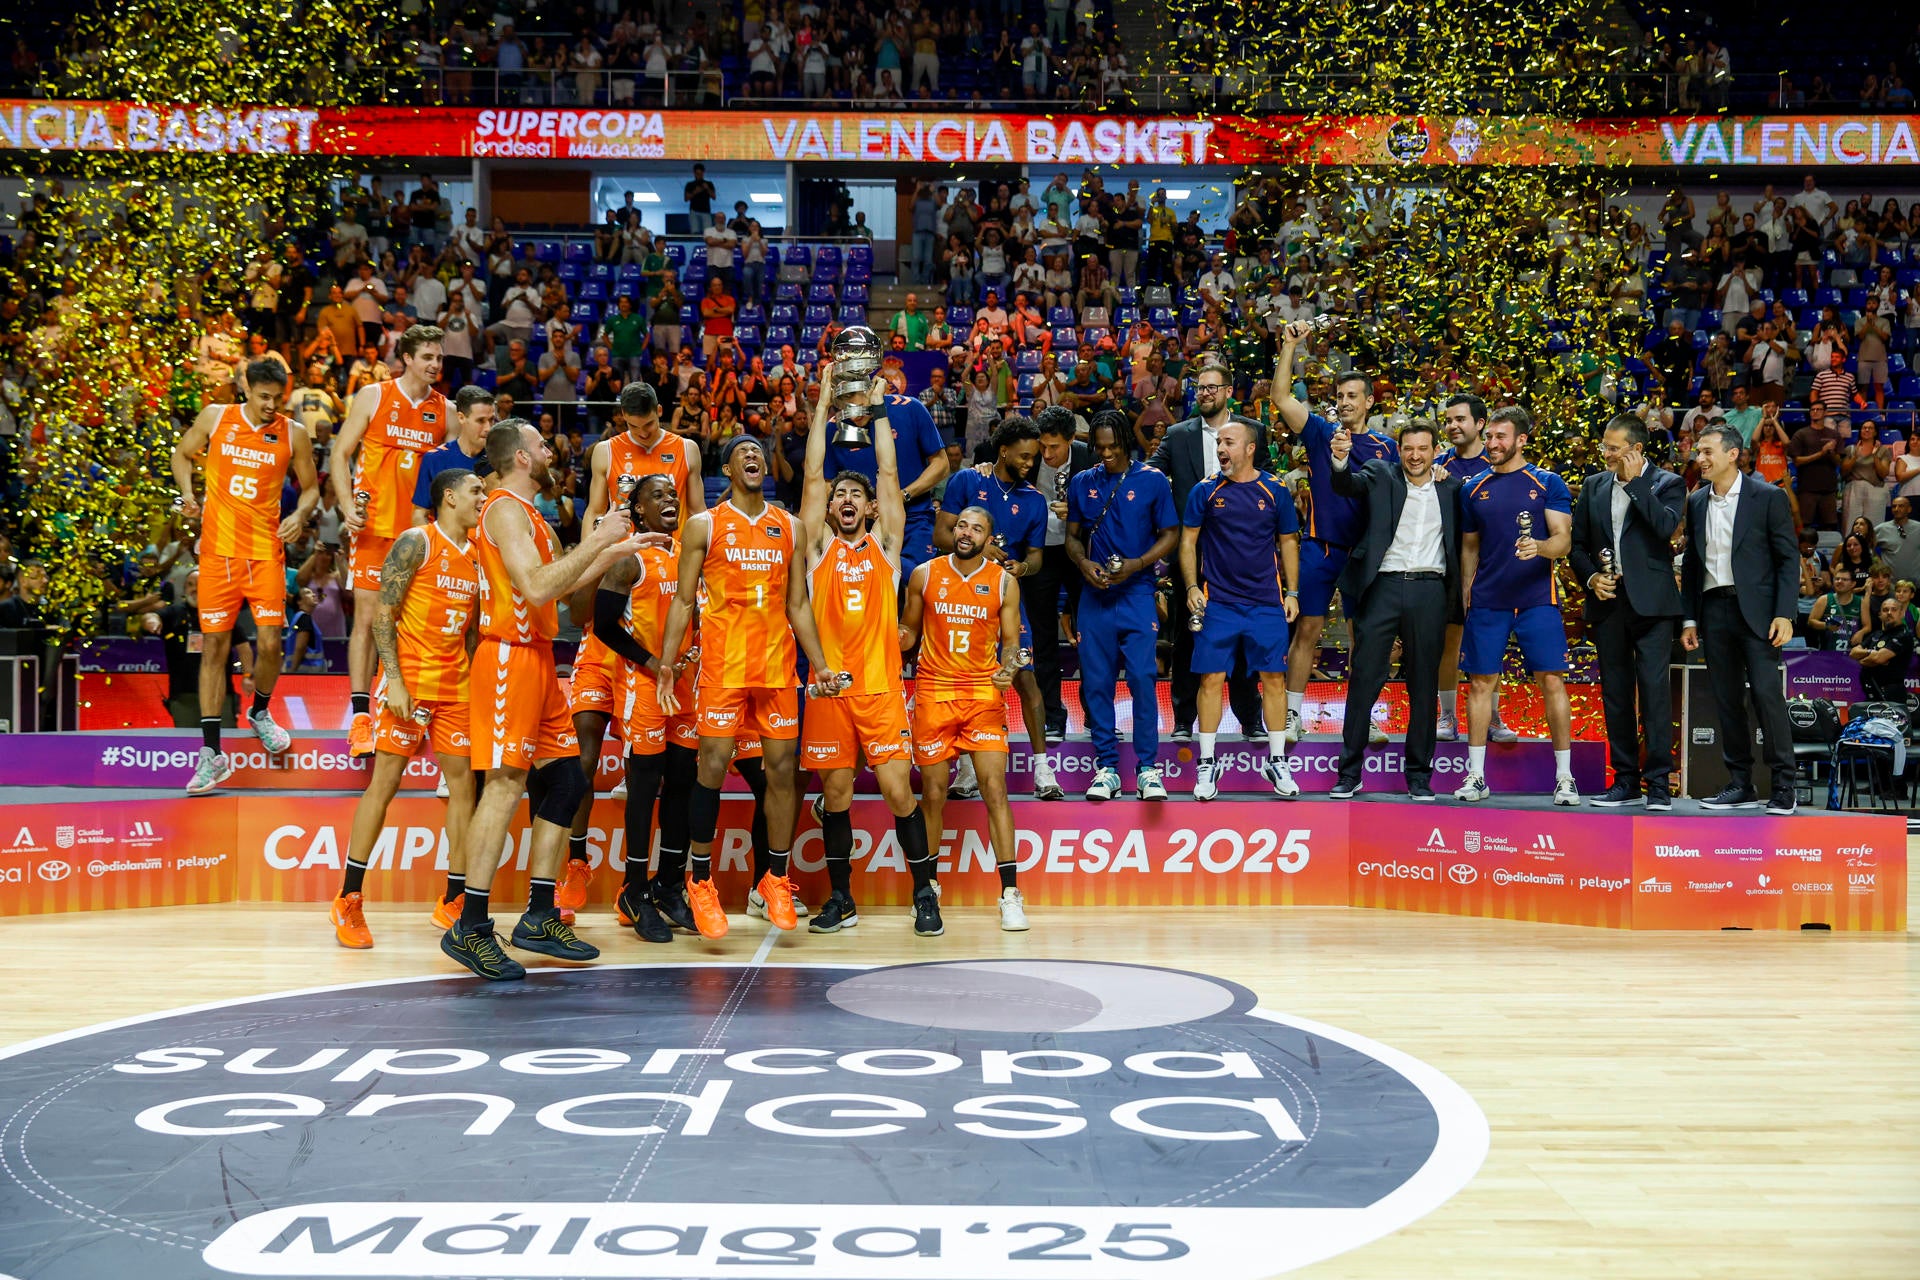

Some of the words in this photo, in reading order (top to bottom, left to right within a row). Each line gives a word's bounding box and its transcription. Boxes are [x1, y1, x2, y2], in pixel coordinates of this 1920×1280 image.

[127, 107, 319, 153] BASKET
[475, 110, 665, 138] SUPERCOPA
[473, 138, 550, 156] endesa
[568, 139, 630, 157] MÁLAGA
[630, 143, 665, 157] 2025
[762, 118, 1013, 162] VALENCIA
[1026, 119, 1215, 164] BASKET
[1661, 121, 1920, 166] VALENCIA
[386, 424, 434, 445] VALENCIA
[397, 438, 422, 449] BASKET
[221, 443, 276, 466] VALENCIA
[232, 457, 262, 469] BASKET
[400, 449, 415, 470] 3
[229, 474, 259, 500] 65
[725, 548, 783, 565] VALENCIA
[741, 562, 771, 571] BASKET
[755, 584, 763, 608] 1
[847, 589, 862, 611] 2
[934, 601, 988, 620] VALENCIA
[441, 608, 468, 635] 32
[946, 616, 975, 625] BASKET
[948, 630, 971, 654] 13
[1792, 675, 1852, 685] azulmarino
[971, 729, 1001, 742] Midea
[807, 745, 836, 753] PULEVA
[868, 741, 899, 756] Midea
[101, 745, 367, 773] #SuperpaEndesa
[1483, 836, 1508, 844] Ciudad
[1493, 844, 1518, 853] Málaga
[1163, 828, 1312, 874] 2025
[1654, 845, 1701, 858] Wilson
[1714, 847, 1763, 855] azulmarino
[1775, 848, 1822, 856] KUMHO
[1836, 843, 1873, 858] renfe
[88, 860, 162, 876] mediolanum
[177, 855, 220, 870] pelayo
[1357, 860, 1434, 880] endesa
[1493, 868, 1565, 886] mediolanum
[1579, 876, 1623, 892] pelayo
[1688, 880, 1726, 890] Transaher
[1848, 873, 1875, 885] UAX
[1638, 884, 1672, 893] LOTUS
[1791, 882, 1833, 891] ONEBOX
[113, 1047, 1264, 1085] supercopa
[134, 1079, 1306, 1141] endesa
